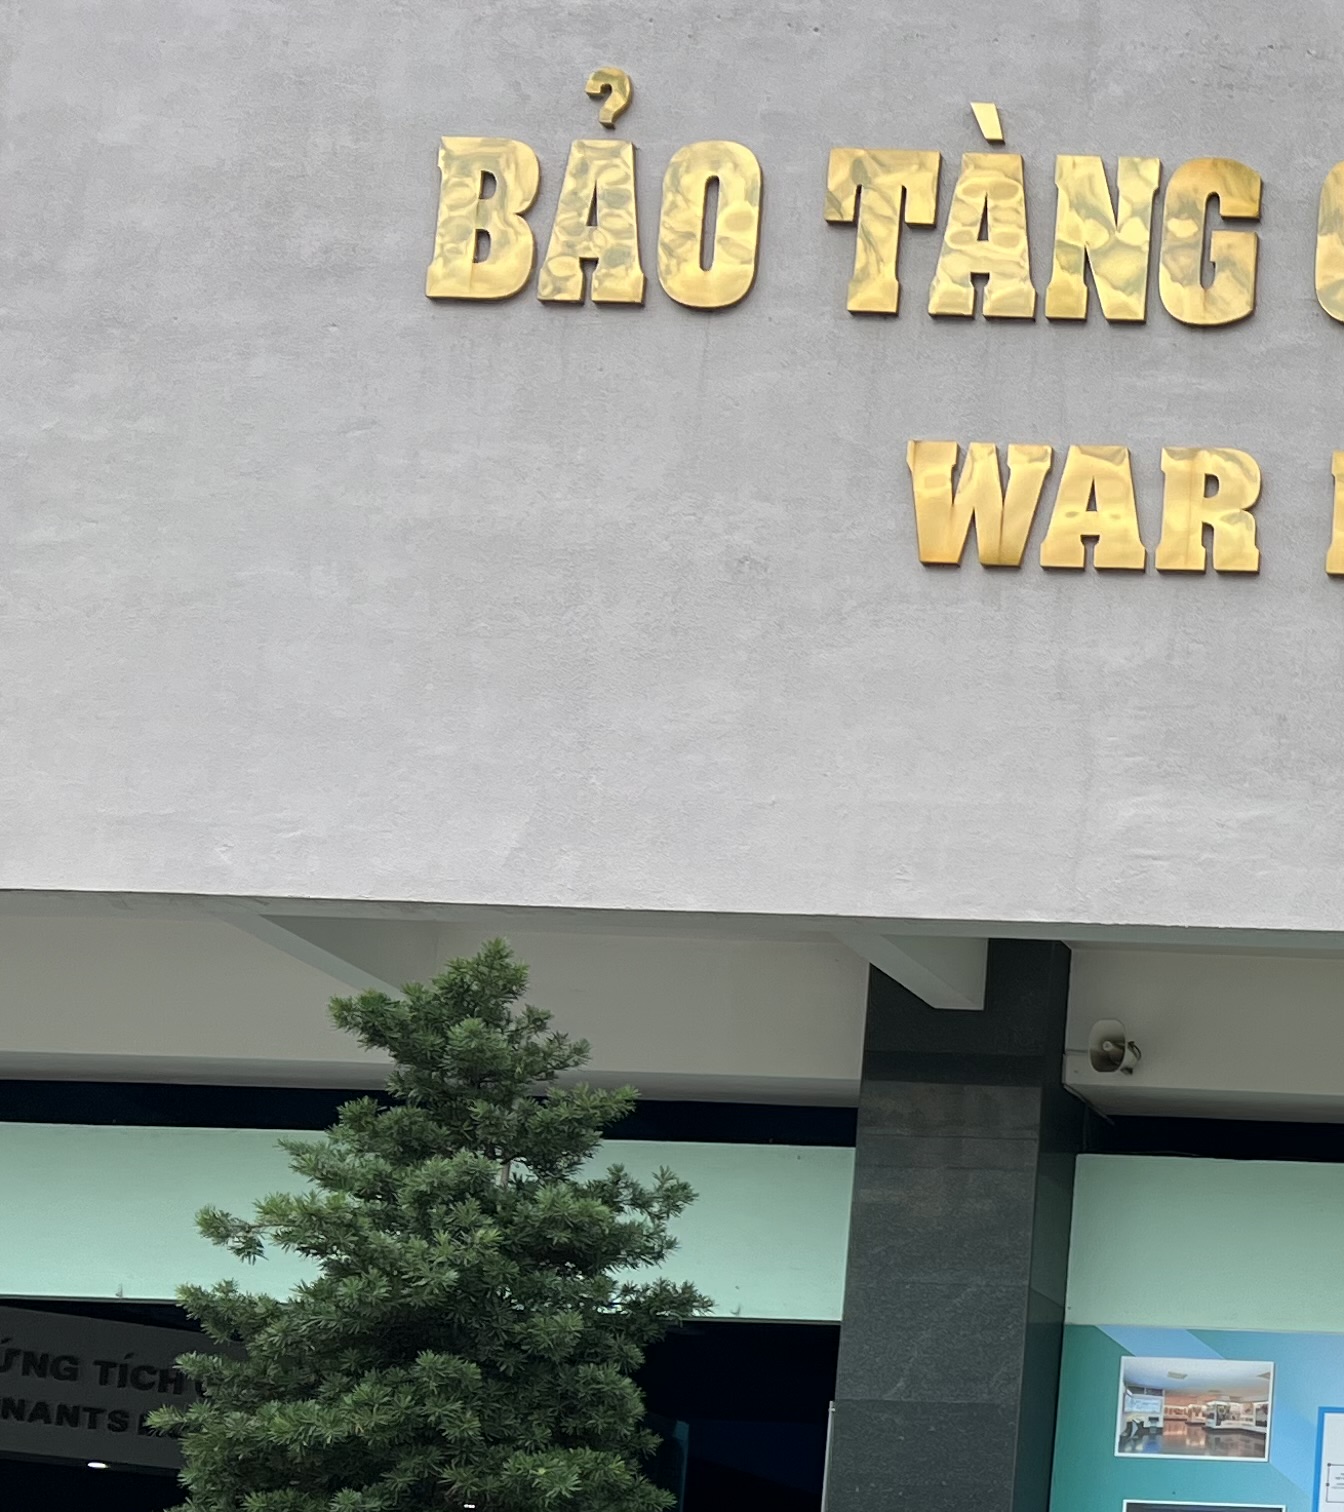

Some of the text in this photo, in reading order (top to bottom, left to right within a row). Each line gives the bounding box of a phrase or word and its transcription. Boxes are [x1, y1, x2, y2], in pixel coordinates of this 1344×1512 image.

[425, 67, 764, 309] BẢO
[824, 102, 1262, 327] TÀNG
[906, 440, 1262, 573] WAR
[93, 1353, 185, 1395] TÍCH
